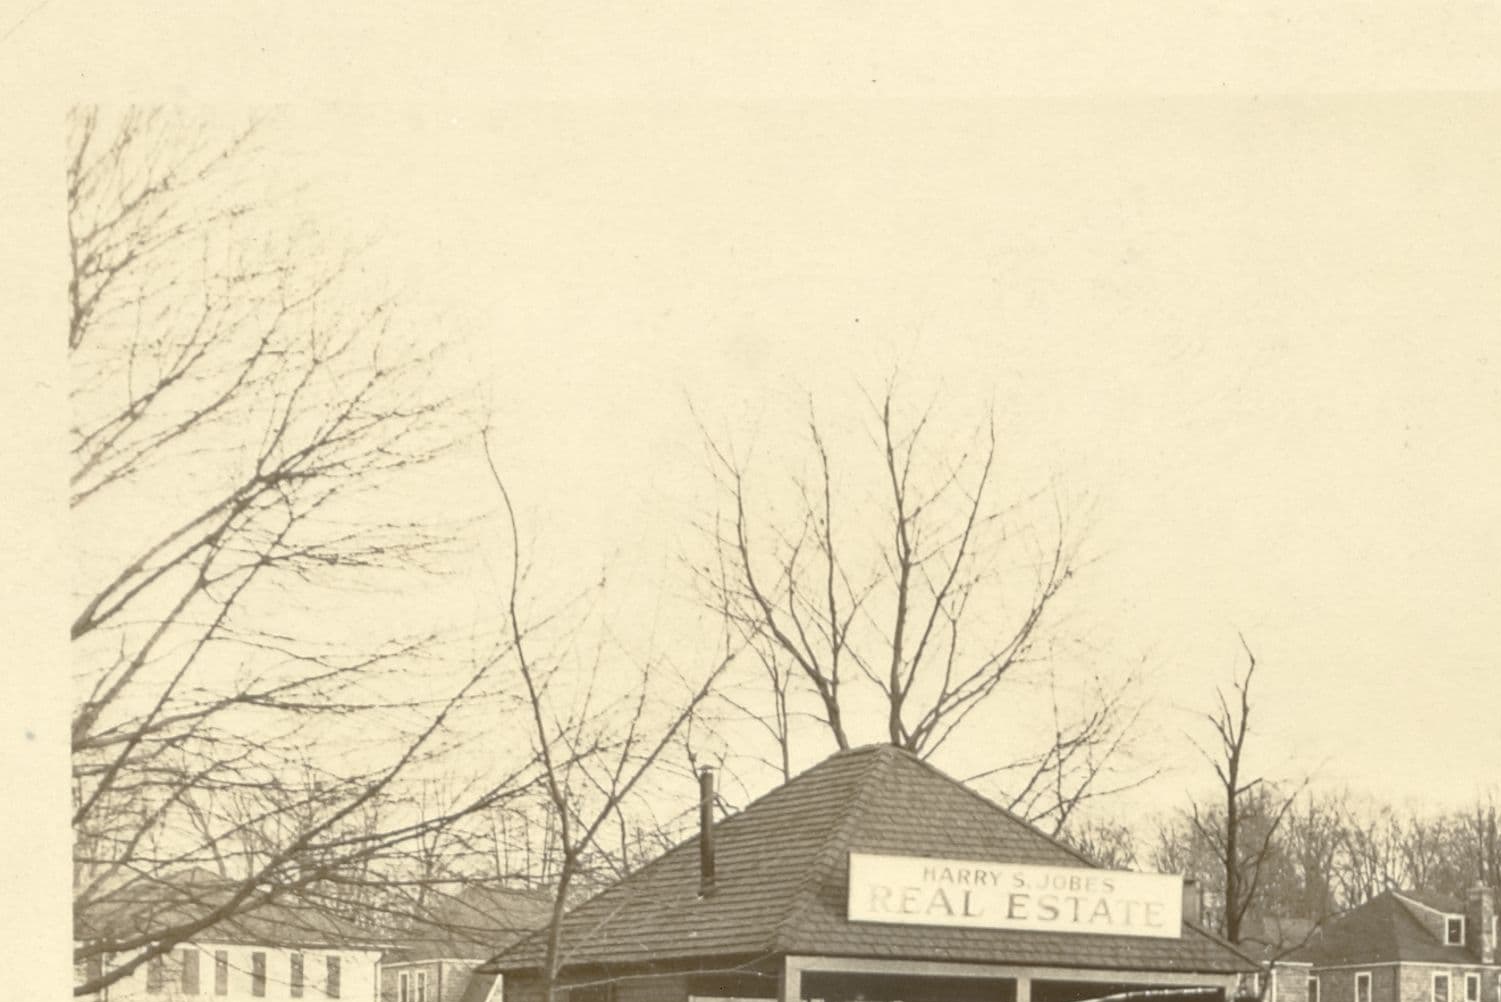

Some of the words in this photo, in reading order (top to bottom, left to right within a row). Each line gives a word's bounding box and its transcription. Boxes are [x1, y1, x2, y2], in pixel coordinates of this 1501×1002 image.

[922, 866, 1003, 887] HARRY
[1012, 871, 1032, 889] S.
[1036, 874, 1116, 894] JOBES
[867, 884, 985, 917] REAL
[1006, 893, 1167, 928] ESTATE
